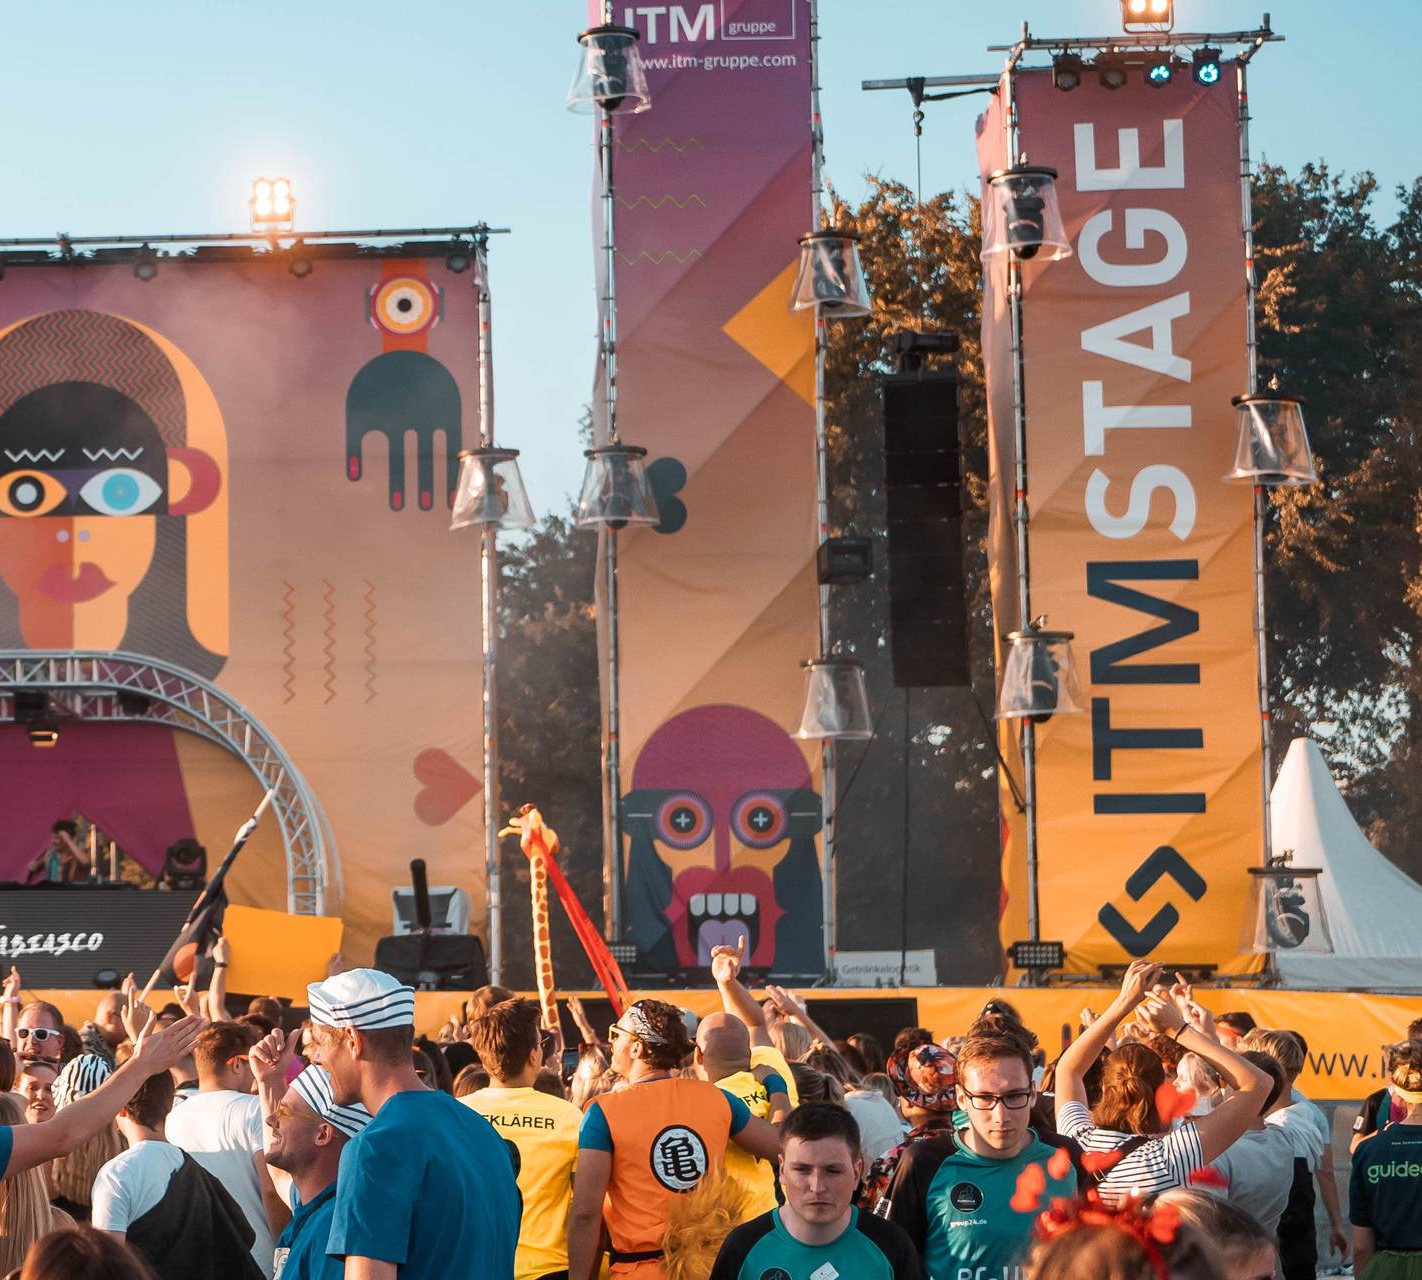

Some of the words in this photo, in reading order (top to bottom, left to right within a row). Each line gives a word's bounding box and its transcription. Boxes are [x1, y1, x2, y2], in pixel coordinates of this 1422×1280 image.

[729, 22, 776, 35] gruppe
[640, 54, 796, 70] ww.itm-gruppe.com
[1368, 1160, 1422, 1184] guide
